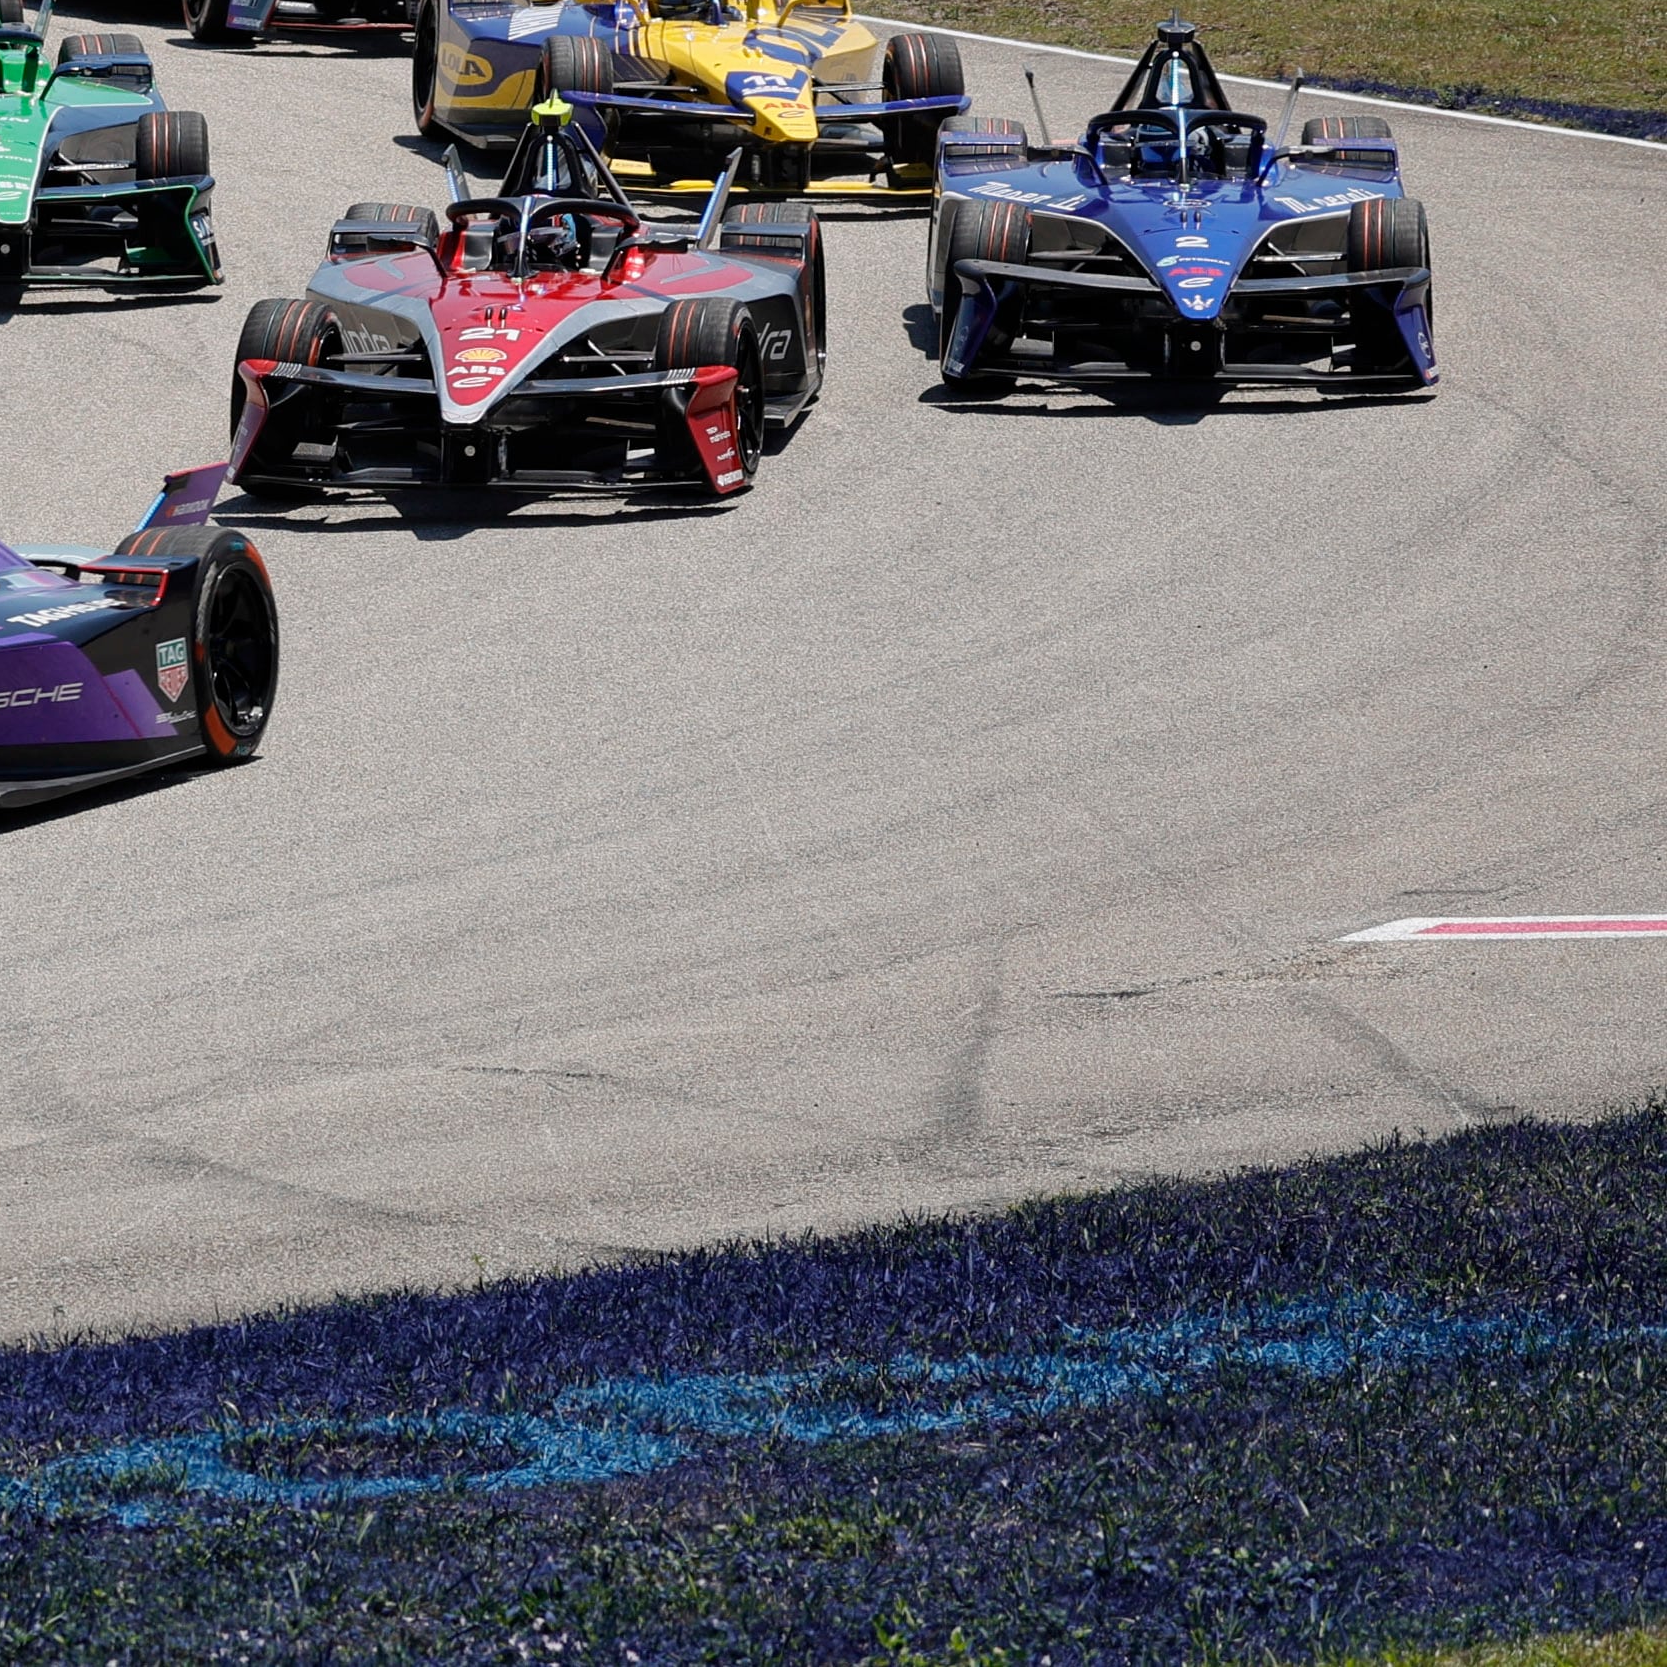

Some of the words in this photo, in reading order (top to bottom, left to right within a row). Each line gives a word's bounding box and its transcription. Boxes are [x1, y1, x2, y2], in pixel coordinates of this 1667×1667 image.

[1175, 235, 1210, 248] 2
[458, 326, 522, 341] 21
[445, 364, 507, 376] ABB
[158, 642, 186, 667] TAG
